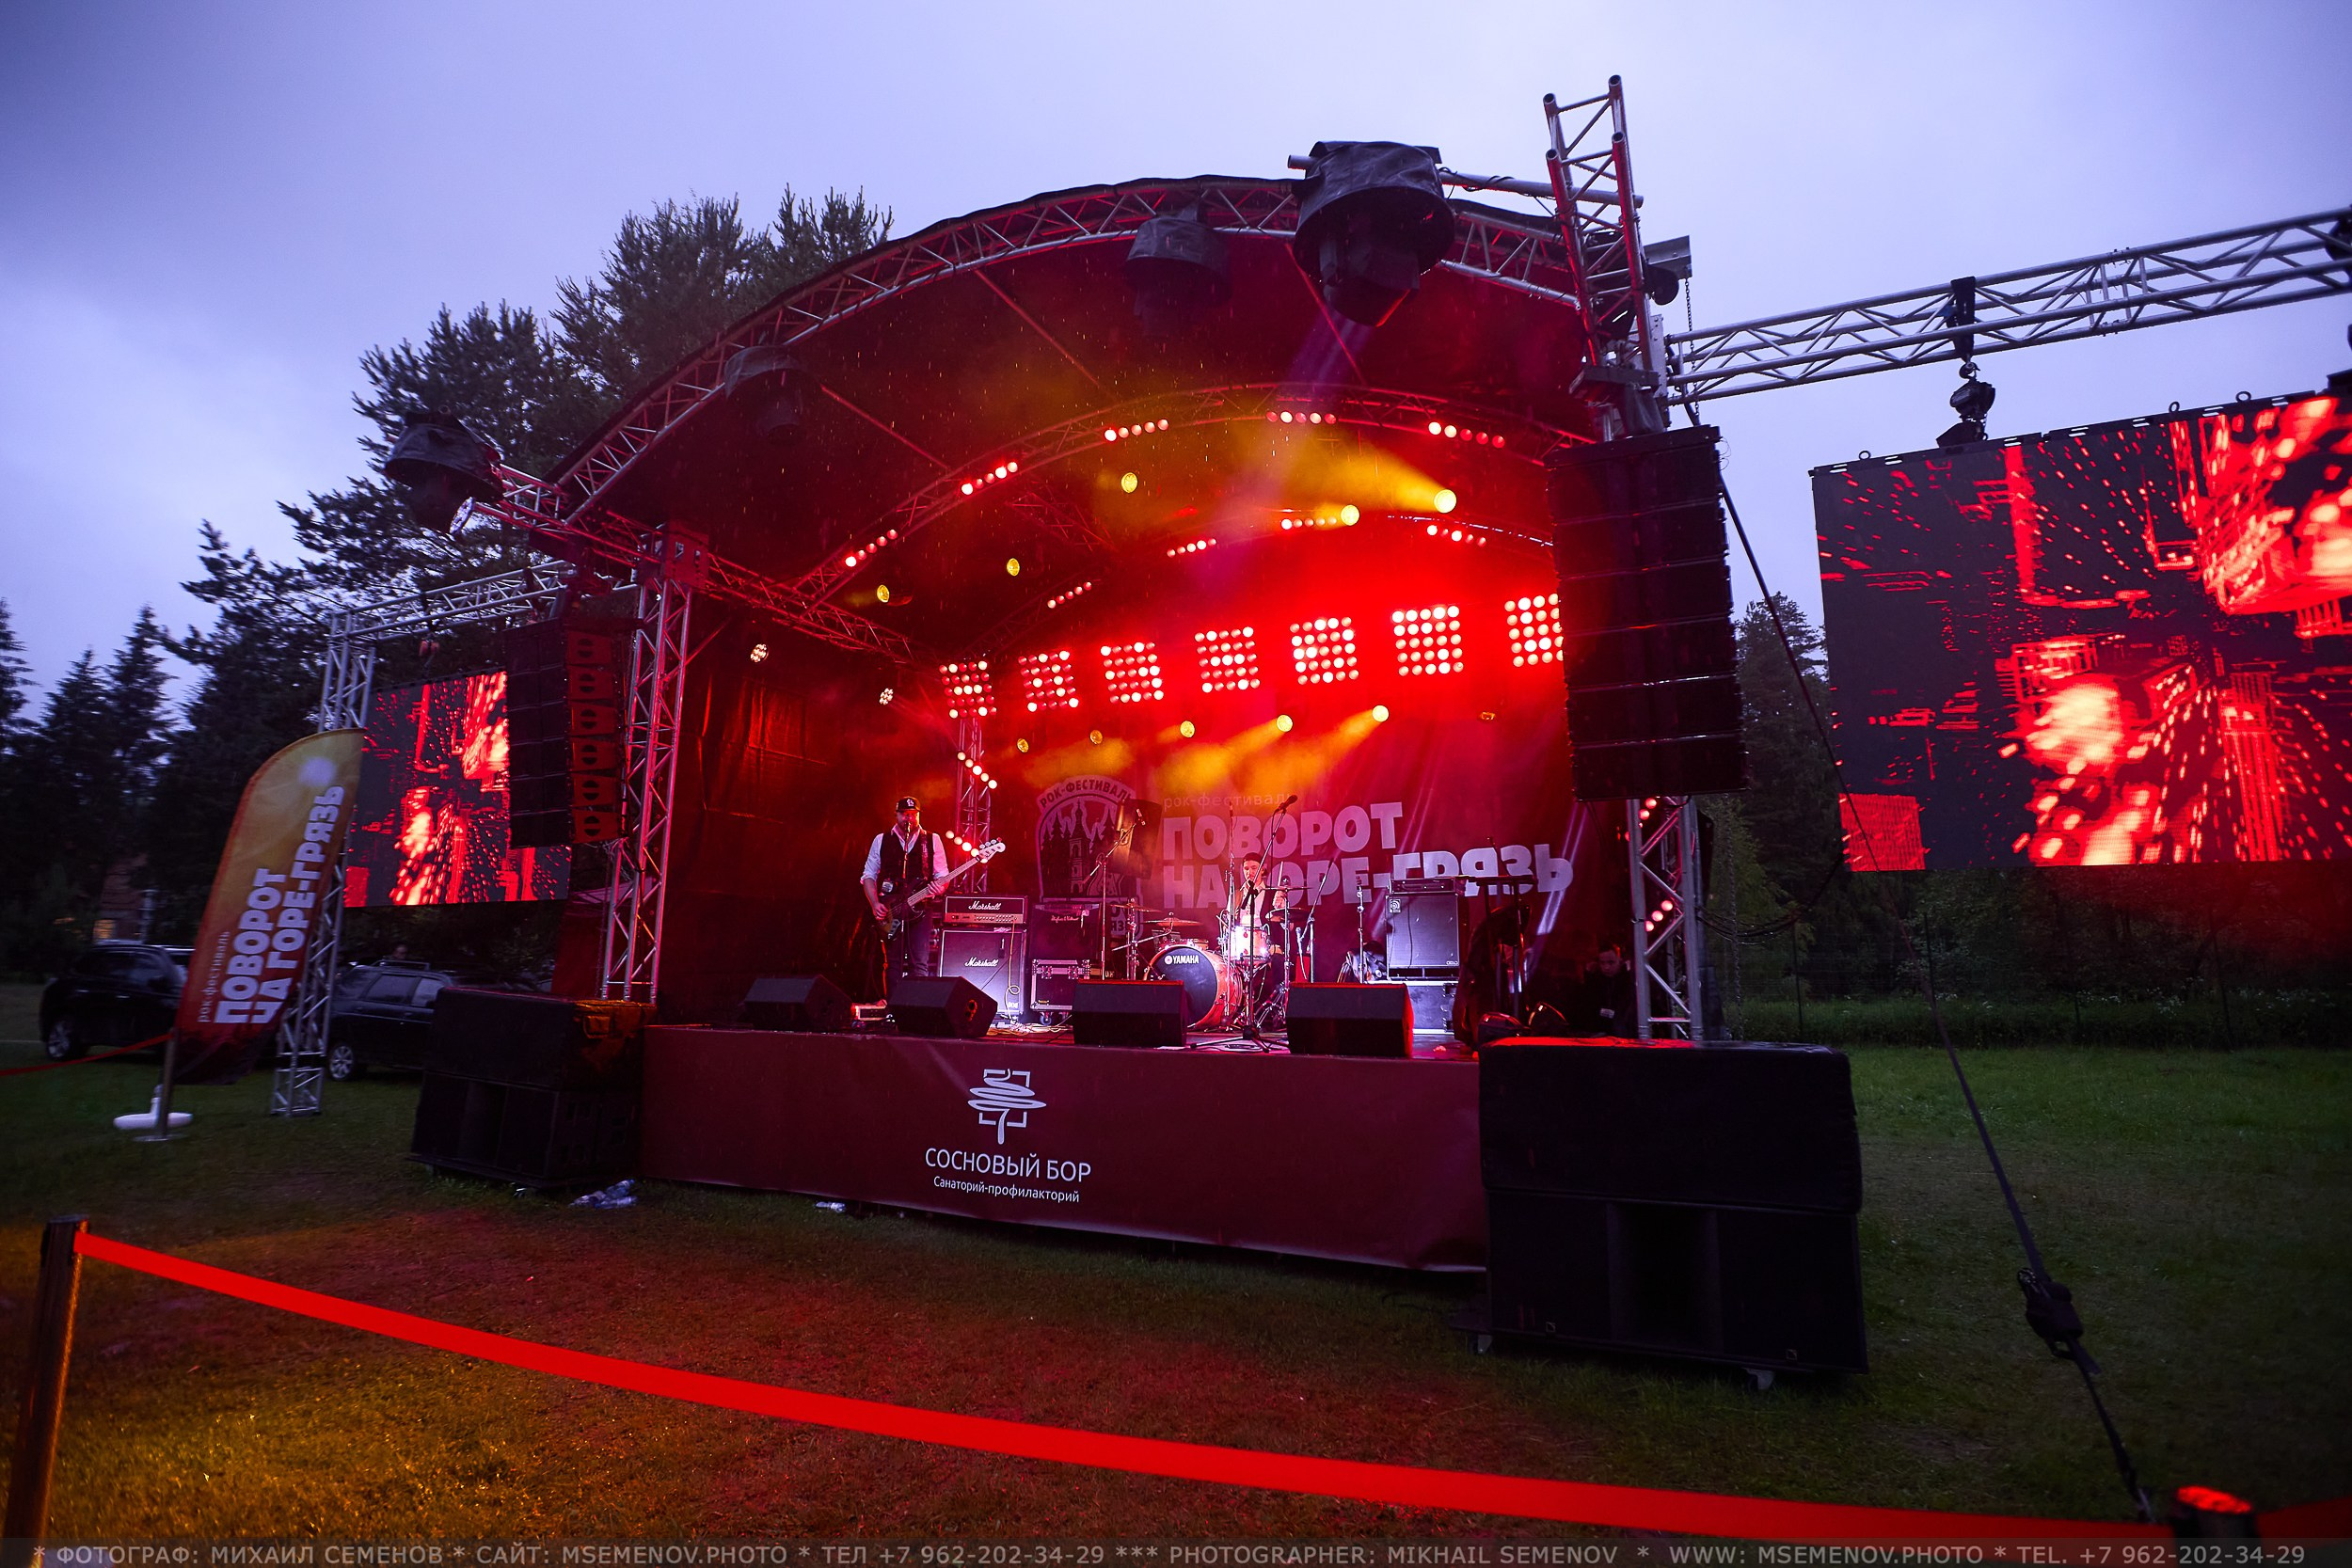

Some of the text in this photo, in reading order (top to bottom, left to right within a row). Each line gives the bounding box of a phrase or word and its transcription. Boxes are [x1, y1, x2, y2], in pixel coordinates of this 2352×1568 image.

[1164, 792, 1291, 813] рок-фестивал
[1163, 801, 1403, 861] ПОВОРОТ
[266, 785, 345, 969] ГОРЕ-ГРЯЗЬ
[1163, 843, 1574, 910] НА ОРЕ-ГРЯЗЬ
[968, 900, 1001, 911] Marshall
[214, 867, 287, 1025] ПОВОРОТ
[1172, 955, 1200, 964] YAMAHA
[964, 957, 998, 967] Marshall
[925, 1147, 1091, 1182] СОСНОВЫЙ БОР
[933, 1175, 1080, 1203] Санаторий-профилакторий
